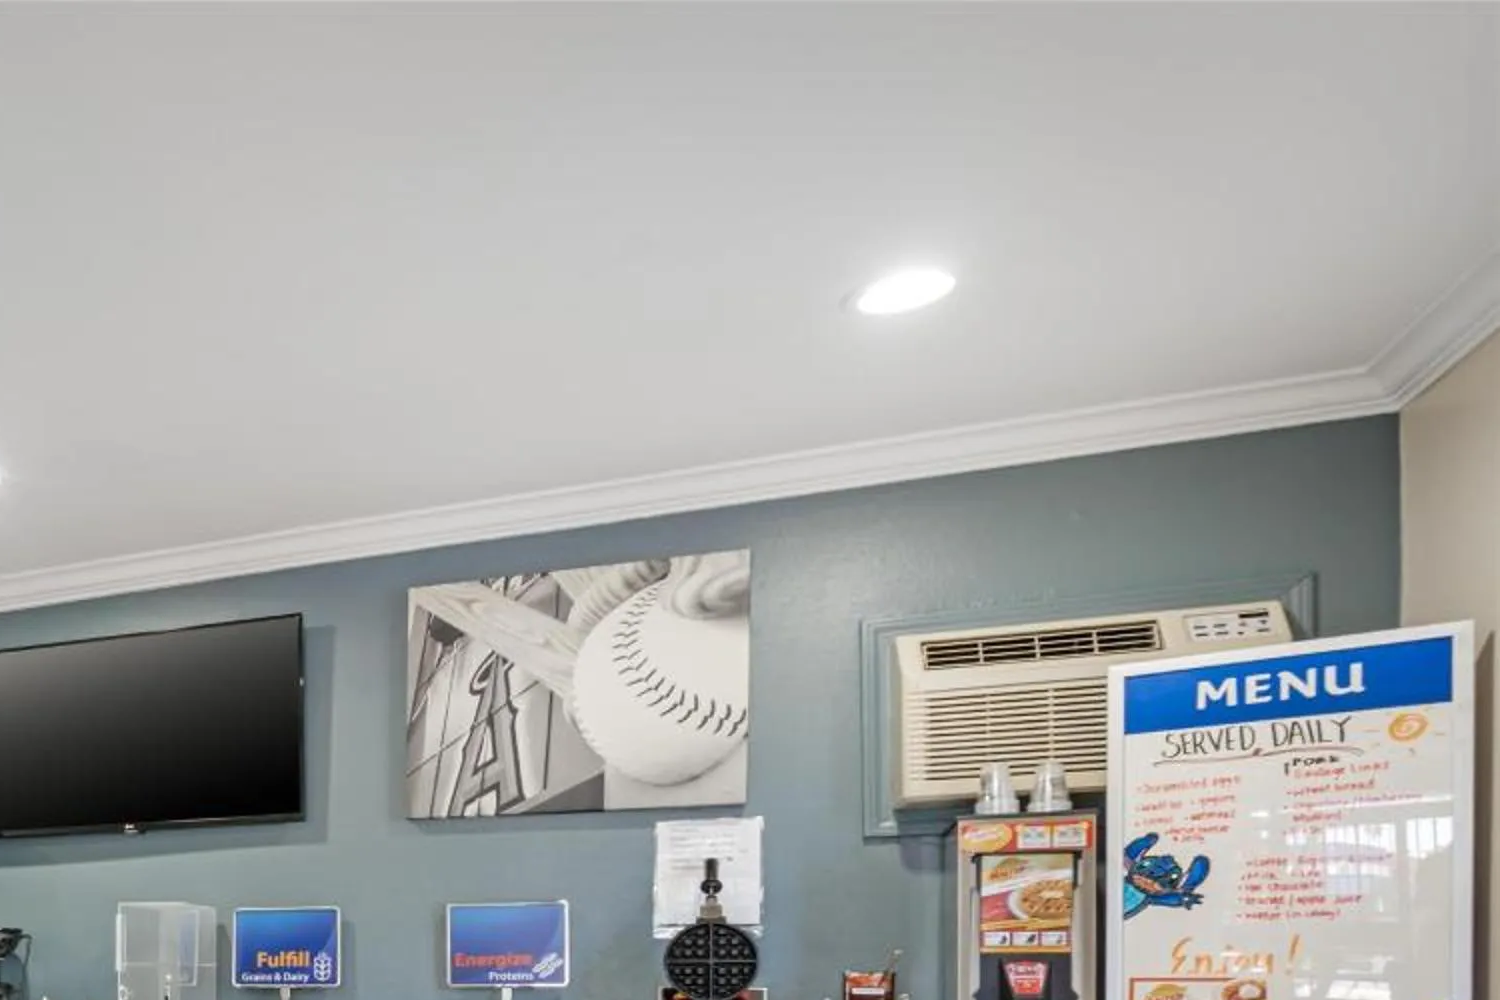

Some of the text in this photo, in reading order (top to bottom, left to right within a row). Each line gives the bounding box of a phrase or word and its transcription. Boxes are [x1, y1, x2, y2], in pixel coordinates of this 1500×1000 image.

[1195, 661, 1366, 711] MENU
[1161, 715, 1352, 759] SERVED DAILY
[257, 950, 311, 968] Fulfill
[454, 953, 534, 969] Energize
[241, 972, 273, 982] Grains
[284, 972, 311, 984] Dairy
[490, 971, 534, 981] Proteins
